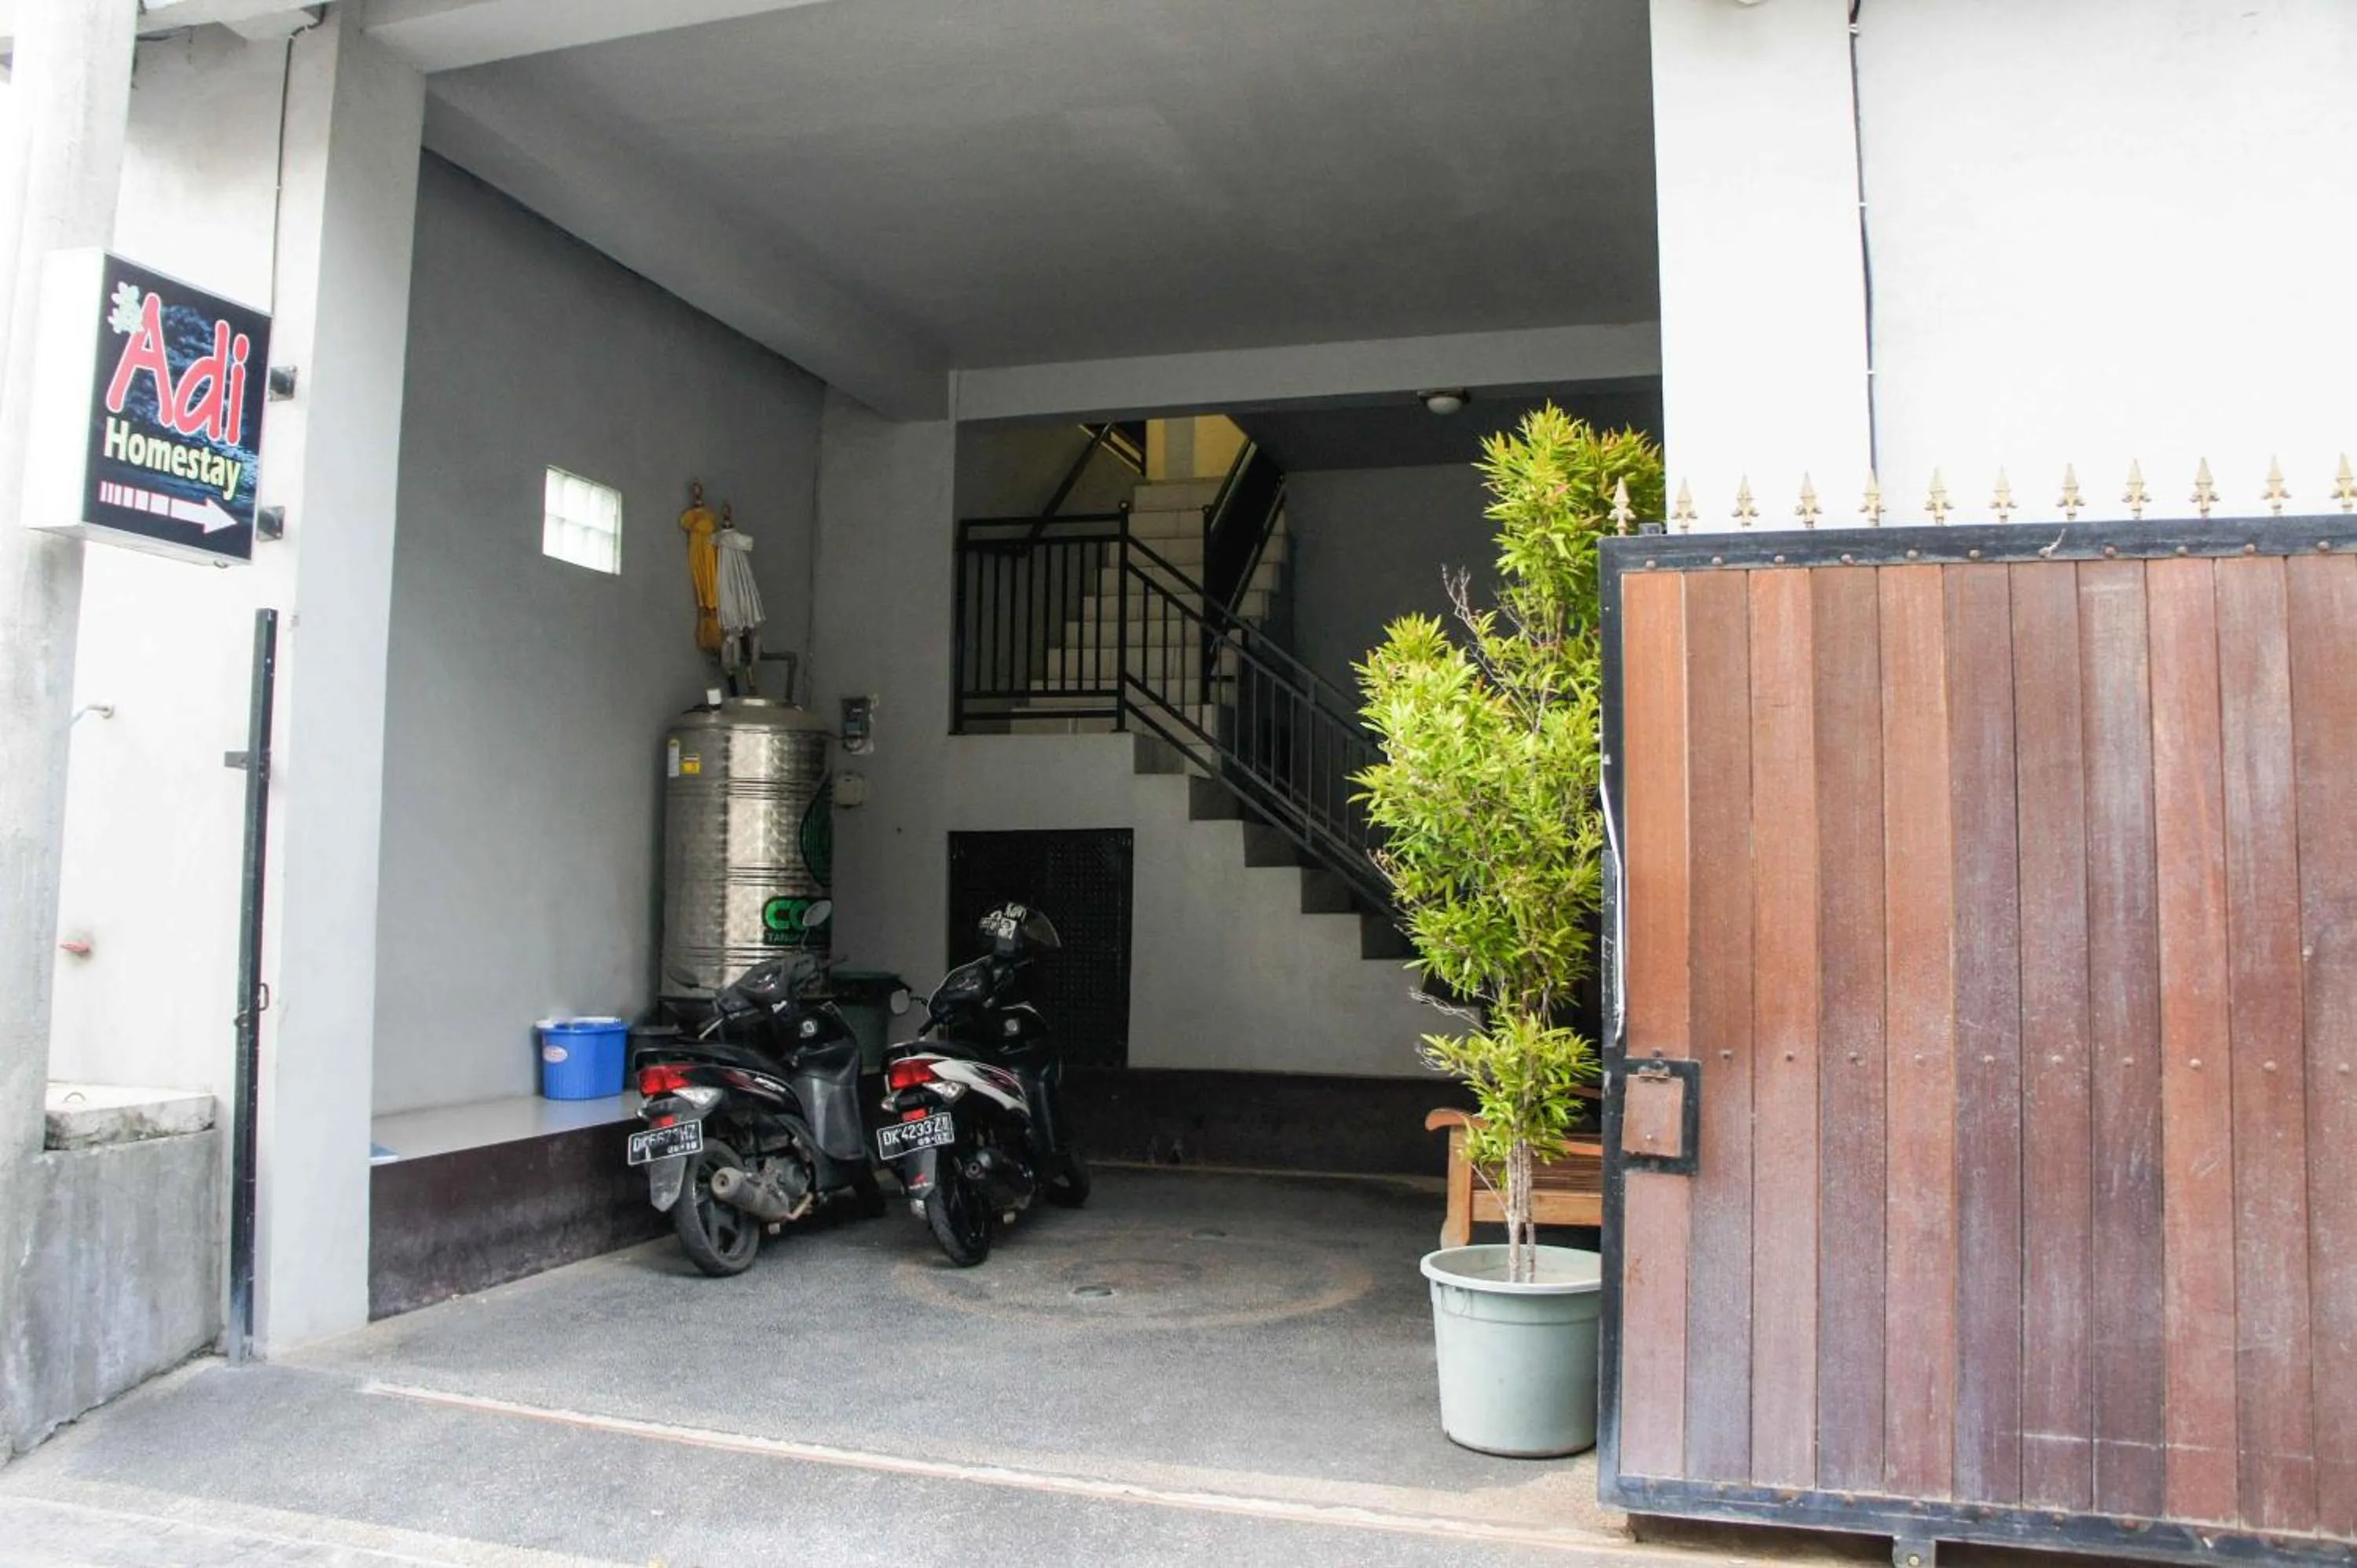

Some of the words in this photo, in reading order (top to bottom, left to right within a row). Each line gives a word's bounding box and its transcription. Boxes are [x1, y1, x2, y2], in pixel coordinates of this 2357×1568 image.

[106, 292, 250, 445] Adi
[104, 416, 242, 500] Homestay
[882, 1130, 900, 1145] DK
